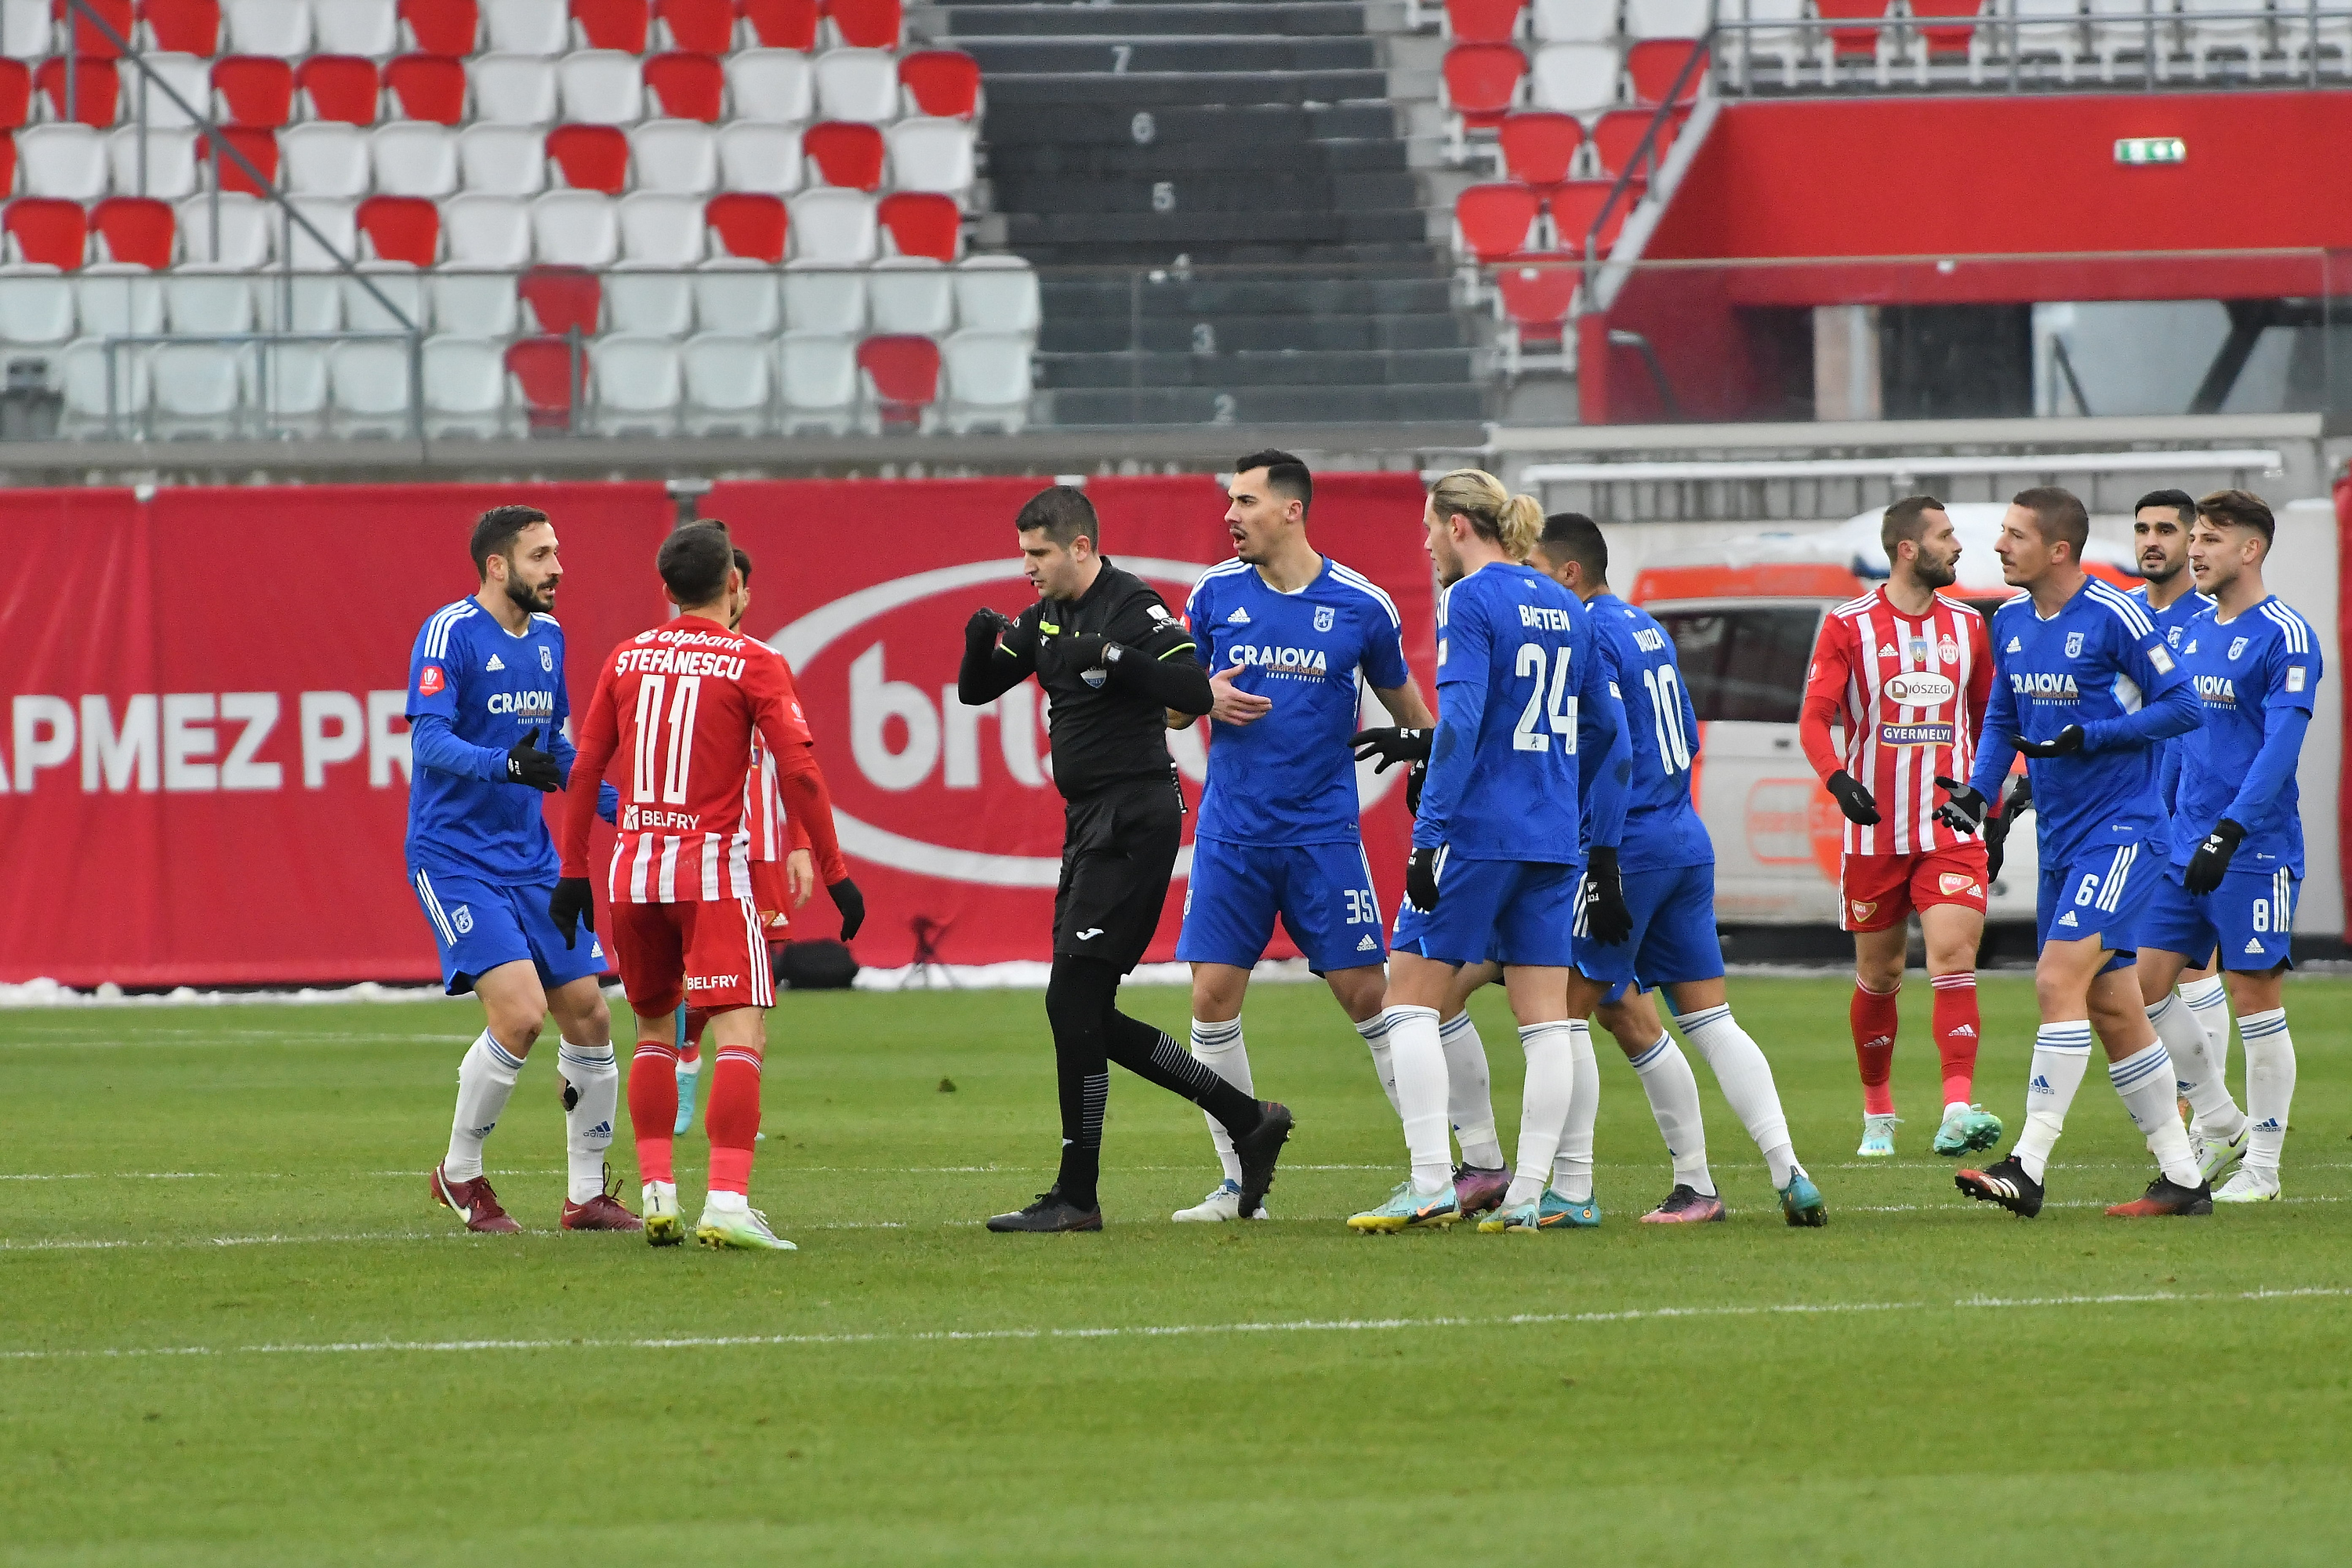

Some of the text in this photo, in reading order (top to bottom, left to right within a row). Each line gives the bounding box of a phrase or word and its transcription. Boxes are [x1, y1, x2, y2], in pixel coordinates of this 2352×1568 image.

[1111, 45, 1131, 74] 7
[1131, 112, 1156, 144] 6
[1152, 181, 1175, 212] 5
[658, 630, 746, 652] otpbank
[1229, 645, 1327, 671] CRAIOVA
[488, 691, 553, 714] CRAIOVA
[1513, 643, 1578, 755] 24
[1643, 664, 1690, 775] 10
[1883, 728, 1951, 740] GYERMELYI
[0, 692, 284, 794] PMEZ
[633, 674, 701, 804] 11
[642, 810, 700, 829] BELFRY
[2074, 873, 2100, 906] 6
[1344, 889, 1374, 924] 35
[2253, 898, 2269, 932] 8
[687, 975, 739, 990] BELFRY
